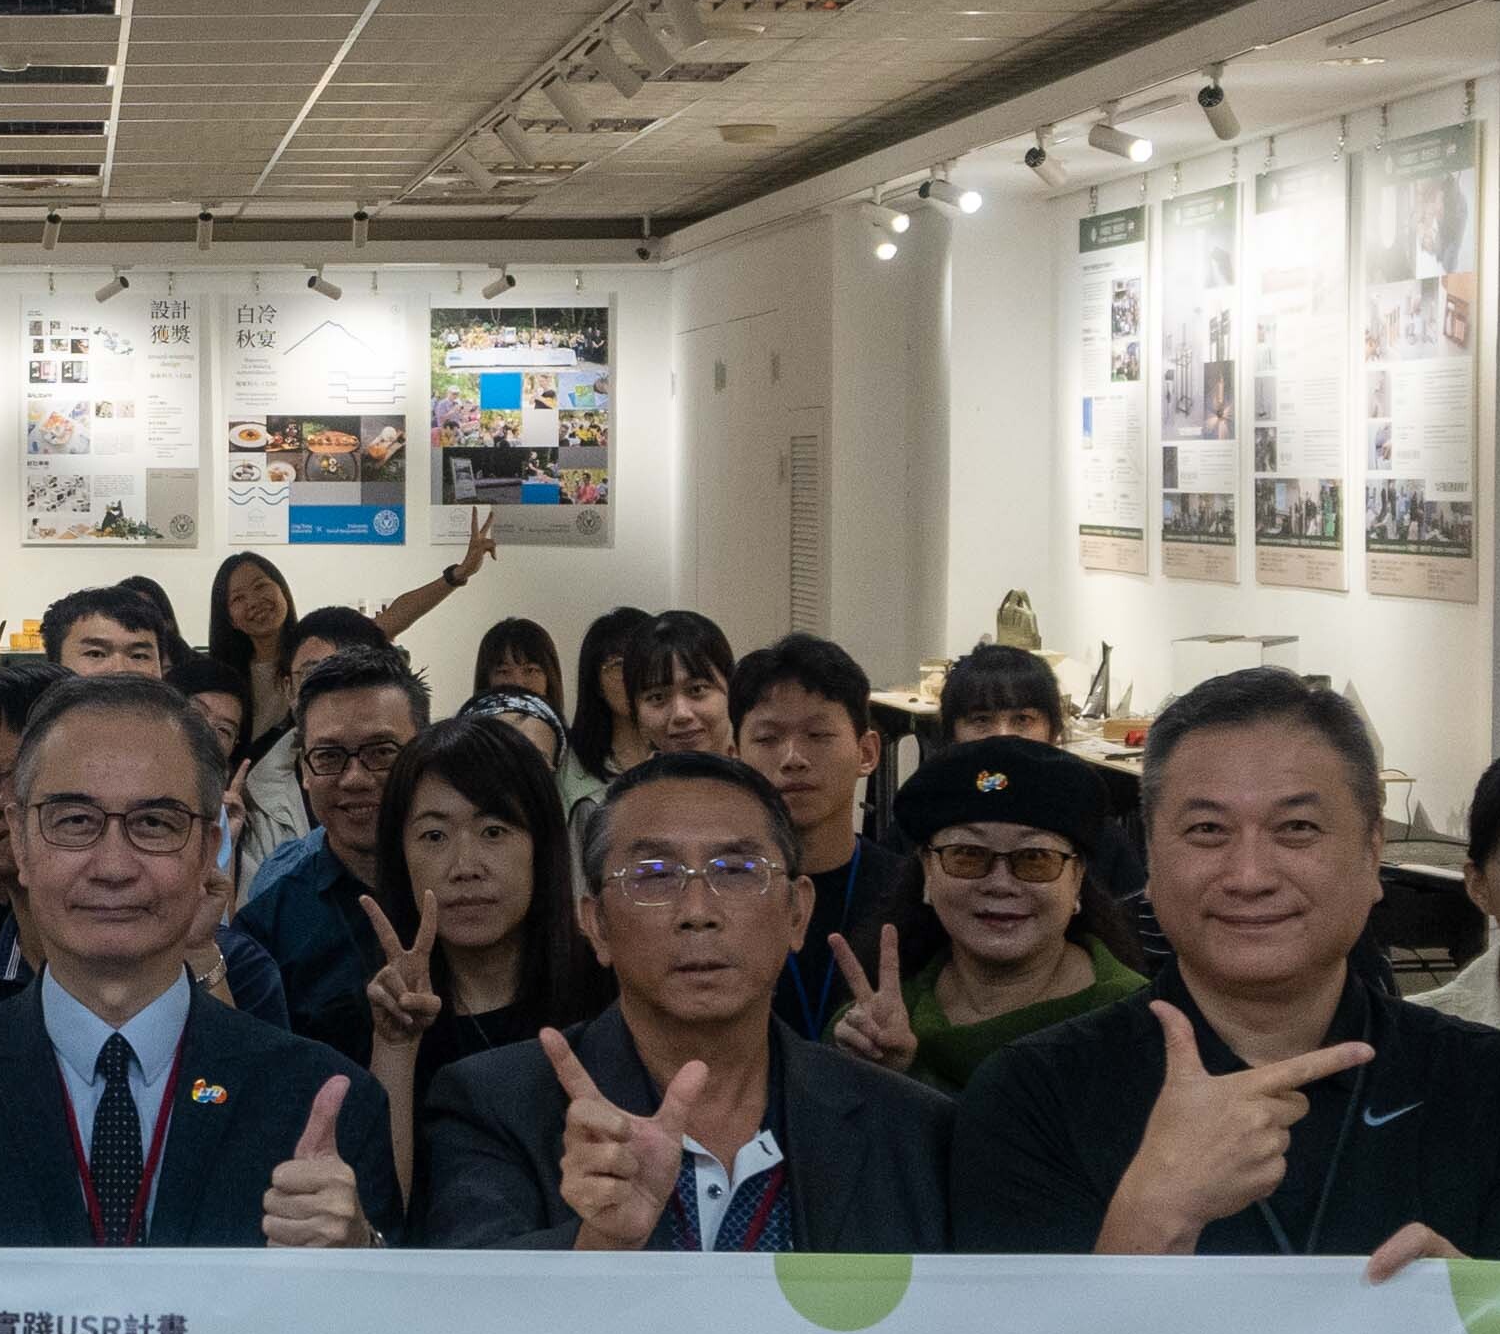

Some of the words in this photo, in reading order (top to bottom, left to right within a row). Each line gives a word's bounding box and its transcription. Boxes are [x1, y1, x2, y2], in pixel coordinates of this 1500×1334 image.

[151, 300, 191, 320] 設計
[238, 304, 277, 324] 白冷
[151, 324, 191, 344] 獲獎
[237, 329, 276, 348] 秋宴
